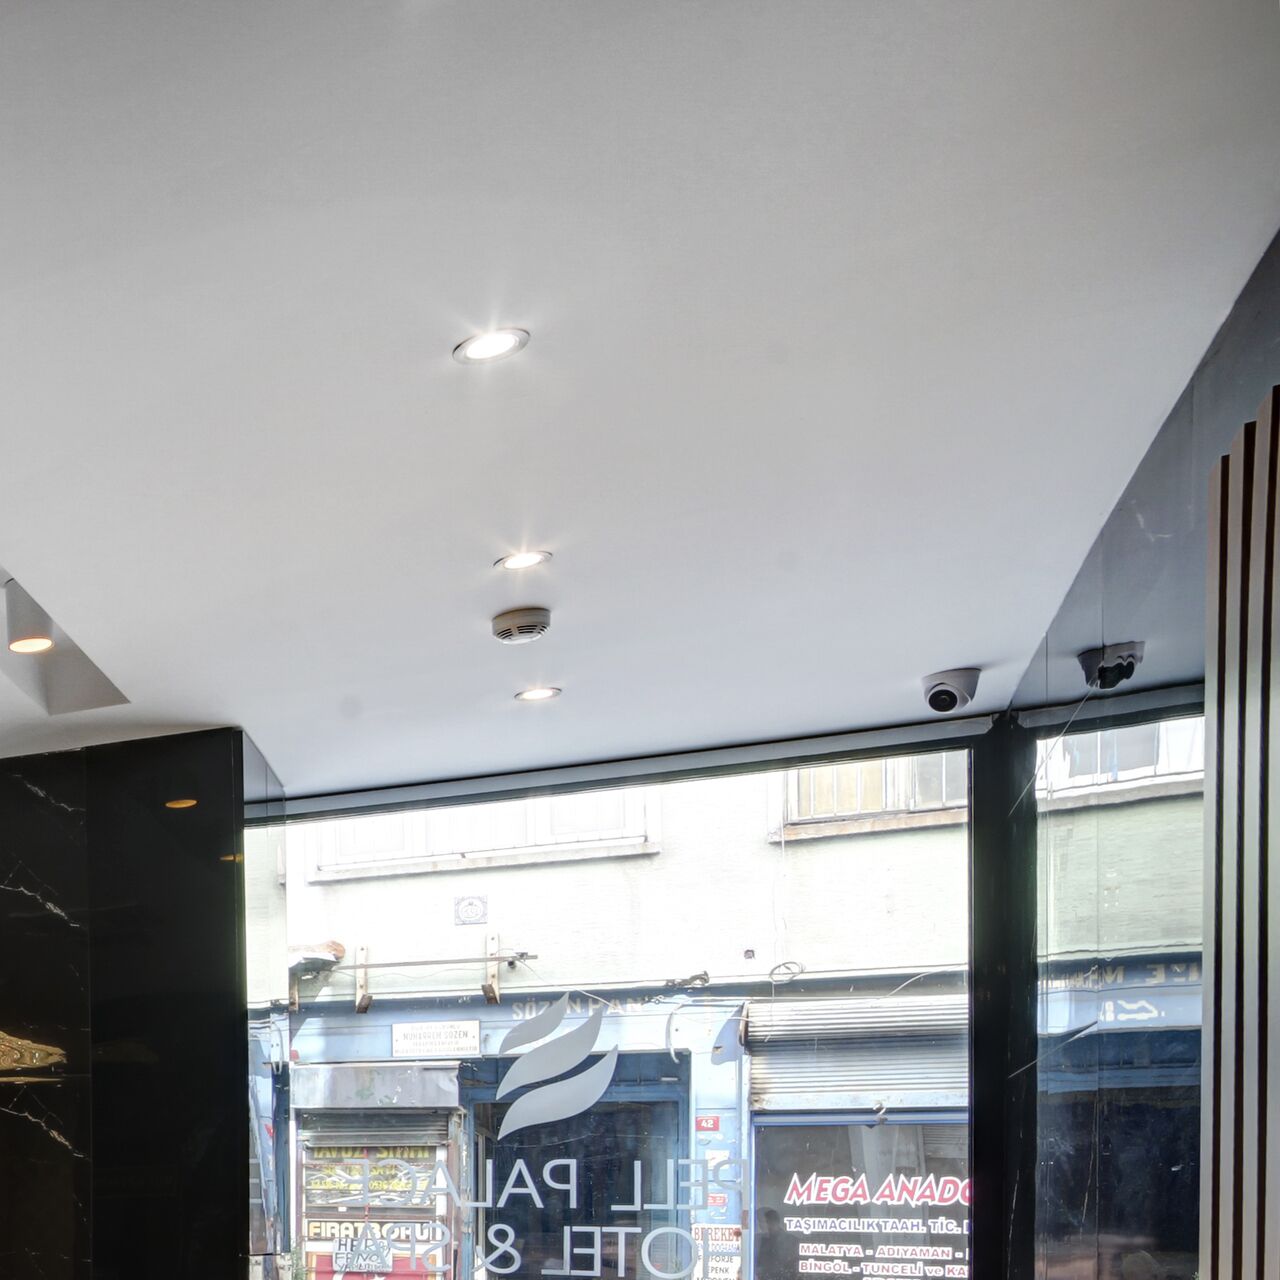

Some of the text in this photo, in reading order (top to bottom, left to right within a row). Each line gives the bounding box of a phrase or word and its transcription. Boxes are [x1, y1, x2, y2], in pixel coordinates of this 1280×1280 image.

[701, 1118, 714, 1128] 42
[784, 1172, 871, 1206] MEGA
[784, 1217, 879, 1234] TAŞIMACILIK
[880, 1218, 926, 1233] TAAH.
[928, 1216, 961, 1233] TİC.
[799, 1243, 864, 1257] MALATYA
[875, 1245, 952, 1260] ADIYAMAN
[799, 1259, 852, 1274] BİNGÖL
[861, 1262, 923, 1276] TUNCELİ
[926, 1267, 943, 1276] ve
[945, 1264, 968, 1278] KA
